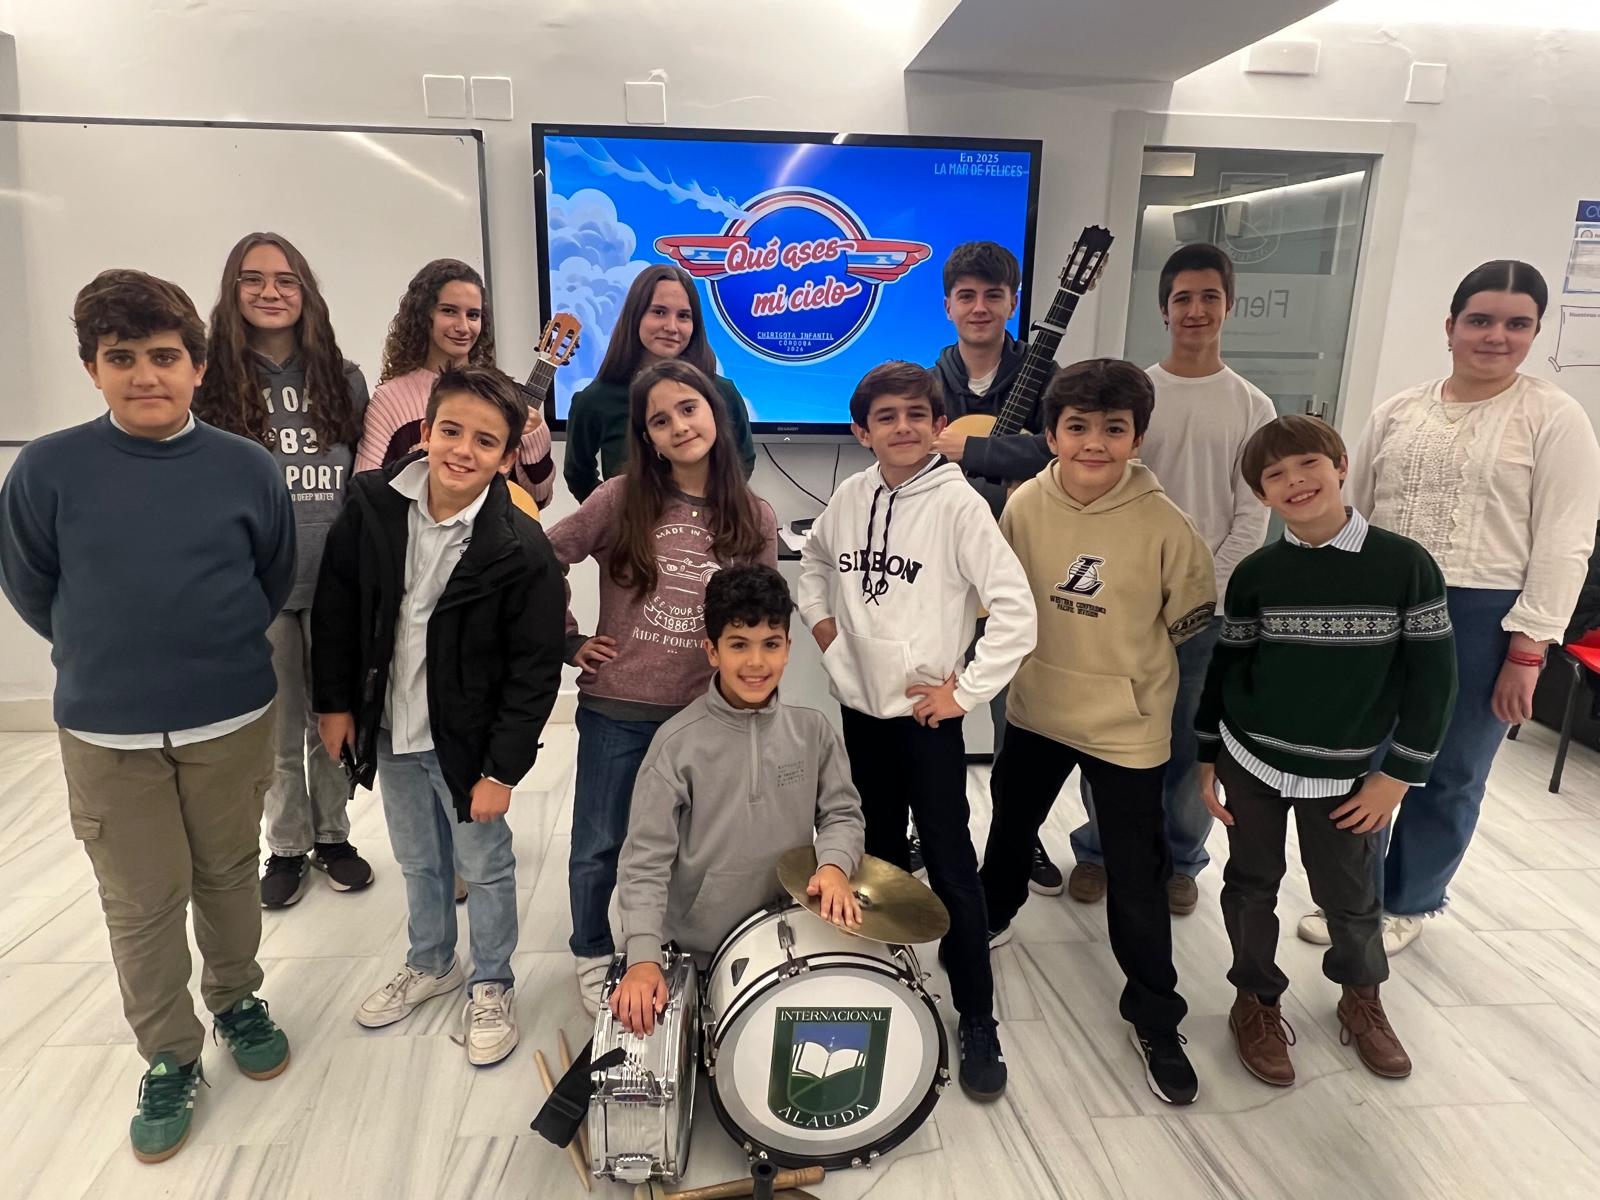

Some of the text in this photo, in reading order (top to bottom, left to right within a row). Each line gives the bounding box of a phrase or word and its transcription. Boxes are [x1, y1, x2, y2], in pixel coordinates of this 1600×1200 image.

[960, 152, 999, 163] En 2025
[934, 163, 1023, 177] LA MAR DE FELICES
[725, 236, 857, 274] Qué ases
[751, 276, 862, 317] mi cielo
[757, 331, 834, 341] CHIRIGOTA INFANTIL
[297, 493, 314, 502] DEEP
[314, 493, 334, 502] WATER
[655, 526, 684, 539] MADE
[691, 529, 701, 537] IN
[669, 605, 694, 616] YOUR
[632, 626, 660, 643] RIDE
[780, 1010, 886, 1021] INTERNACIONAL
[778, 1103, 869, 1128] ALAUDA
